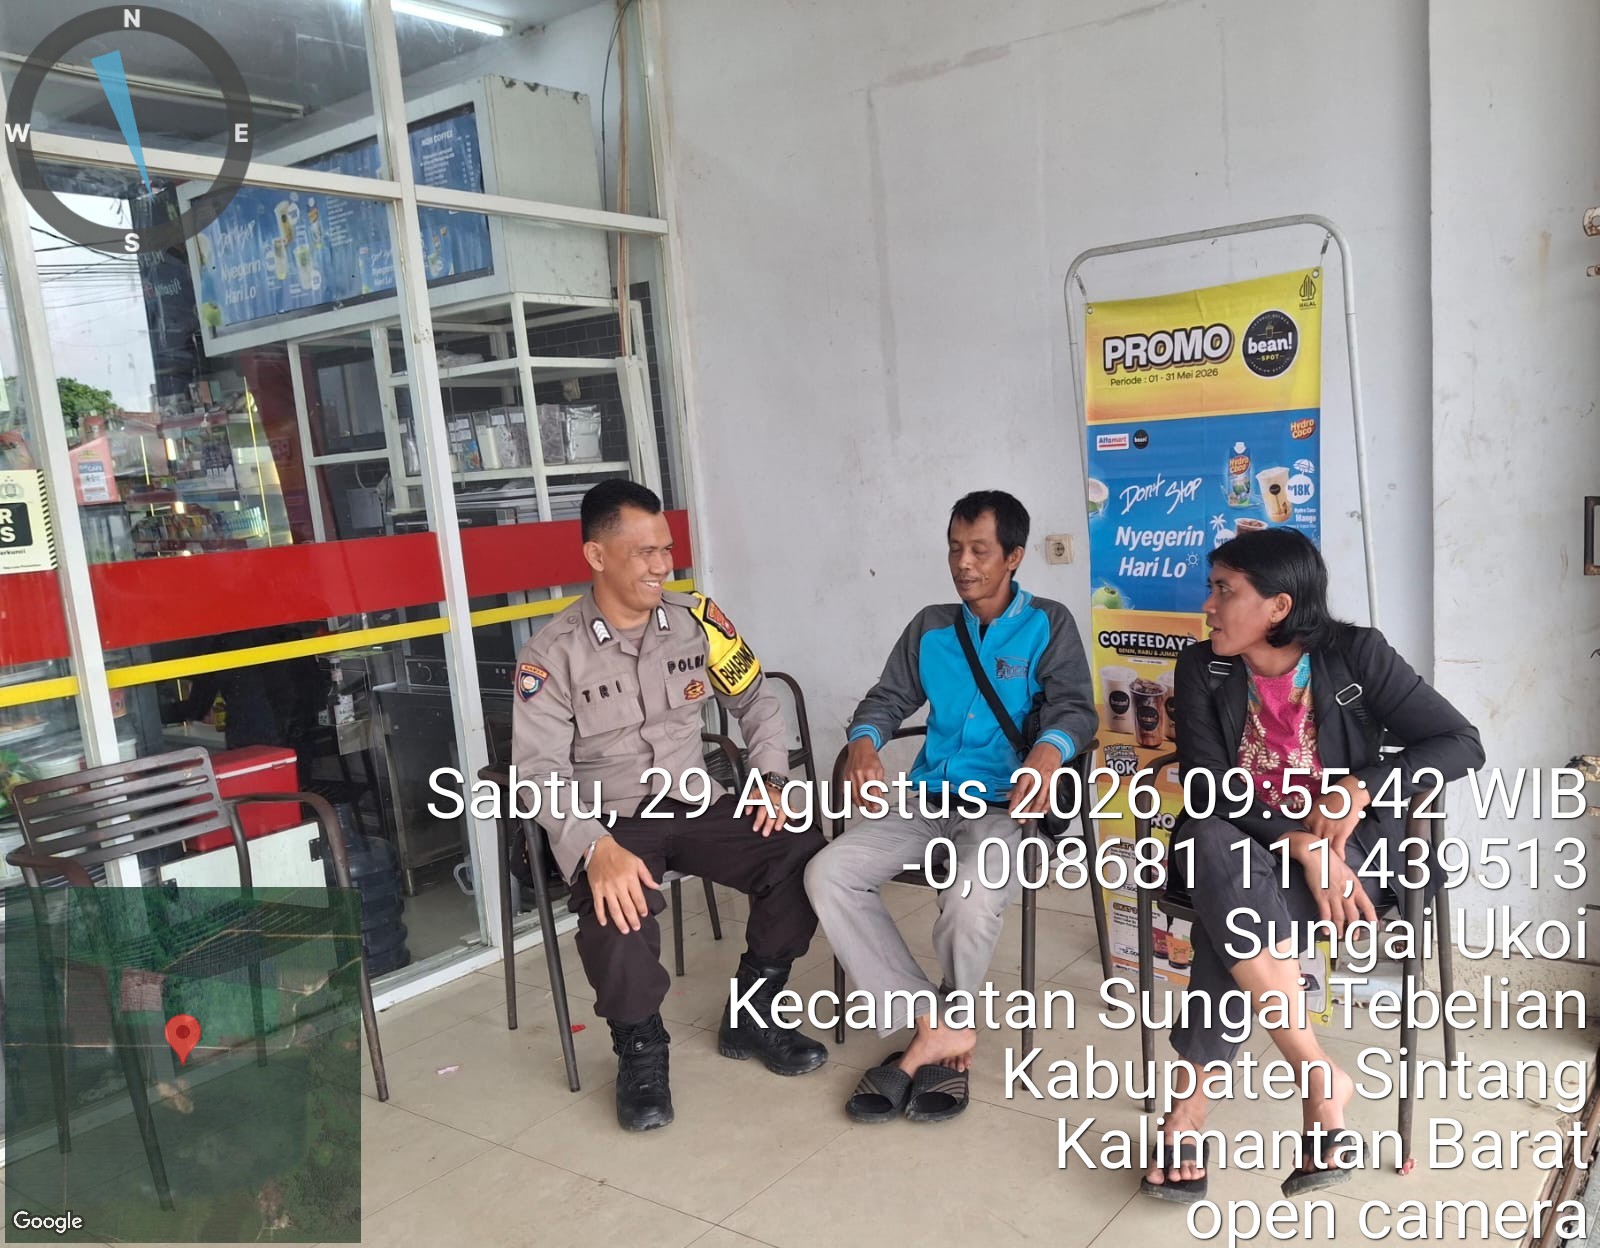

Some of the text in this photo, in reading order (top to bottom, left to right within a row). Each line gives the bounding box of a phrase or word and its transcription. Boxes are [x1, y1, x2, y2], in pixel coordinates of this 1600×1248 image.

[1103, 323, 1234, 374] PROMO
[1248, 331, 1293, 355] bean!
[1261, 353, 1280, 362] SPOT
[1110, 376, 1142, 387] Periode
[1148, 374, 1158, 383] 01
[1166, 374, 1176, 382] 31
[1177, 371, 1194, 380] Mei
[1196, 368, 1218, 379] 2026
[1291, 418, 1314, 431] Hydro
[1292, 426, 1313, 438] Coco
[1164, 477, 1203, 515] Stop
[1115, 525, 1204, 552] Nyegerin
[1118, 557, 1187, 578] Hari Lo
[582, 680, 622, 703] TRI
[1106, 760, 1136, 775] 10K
